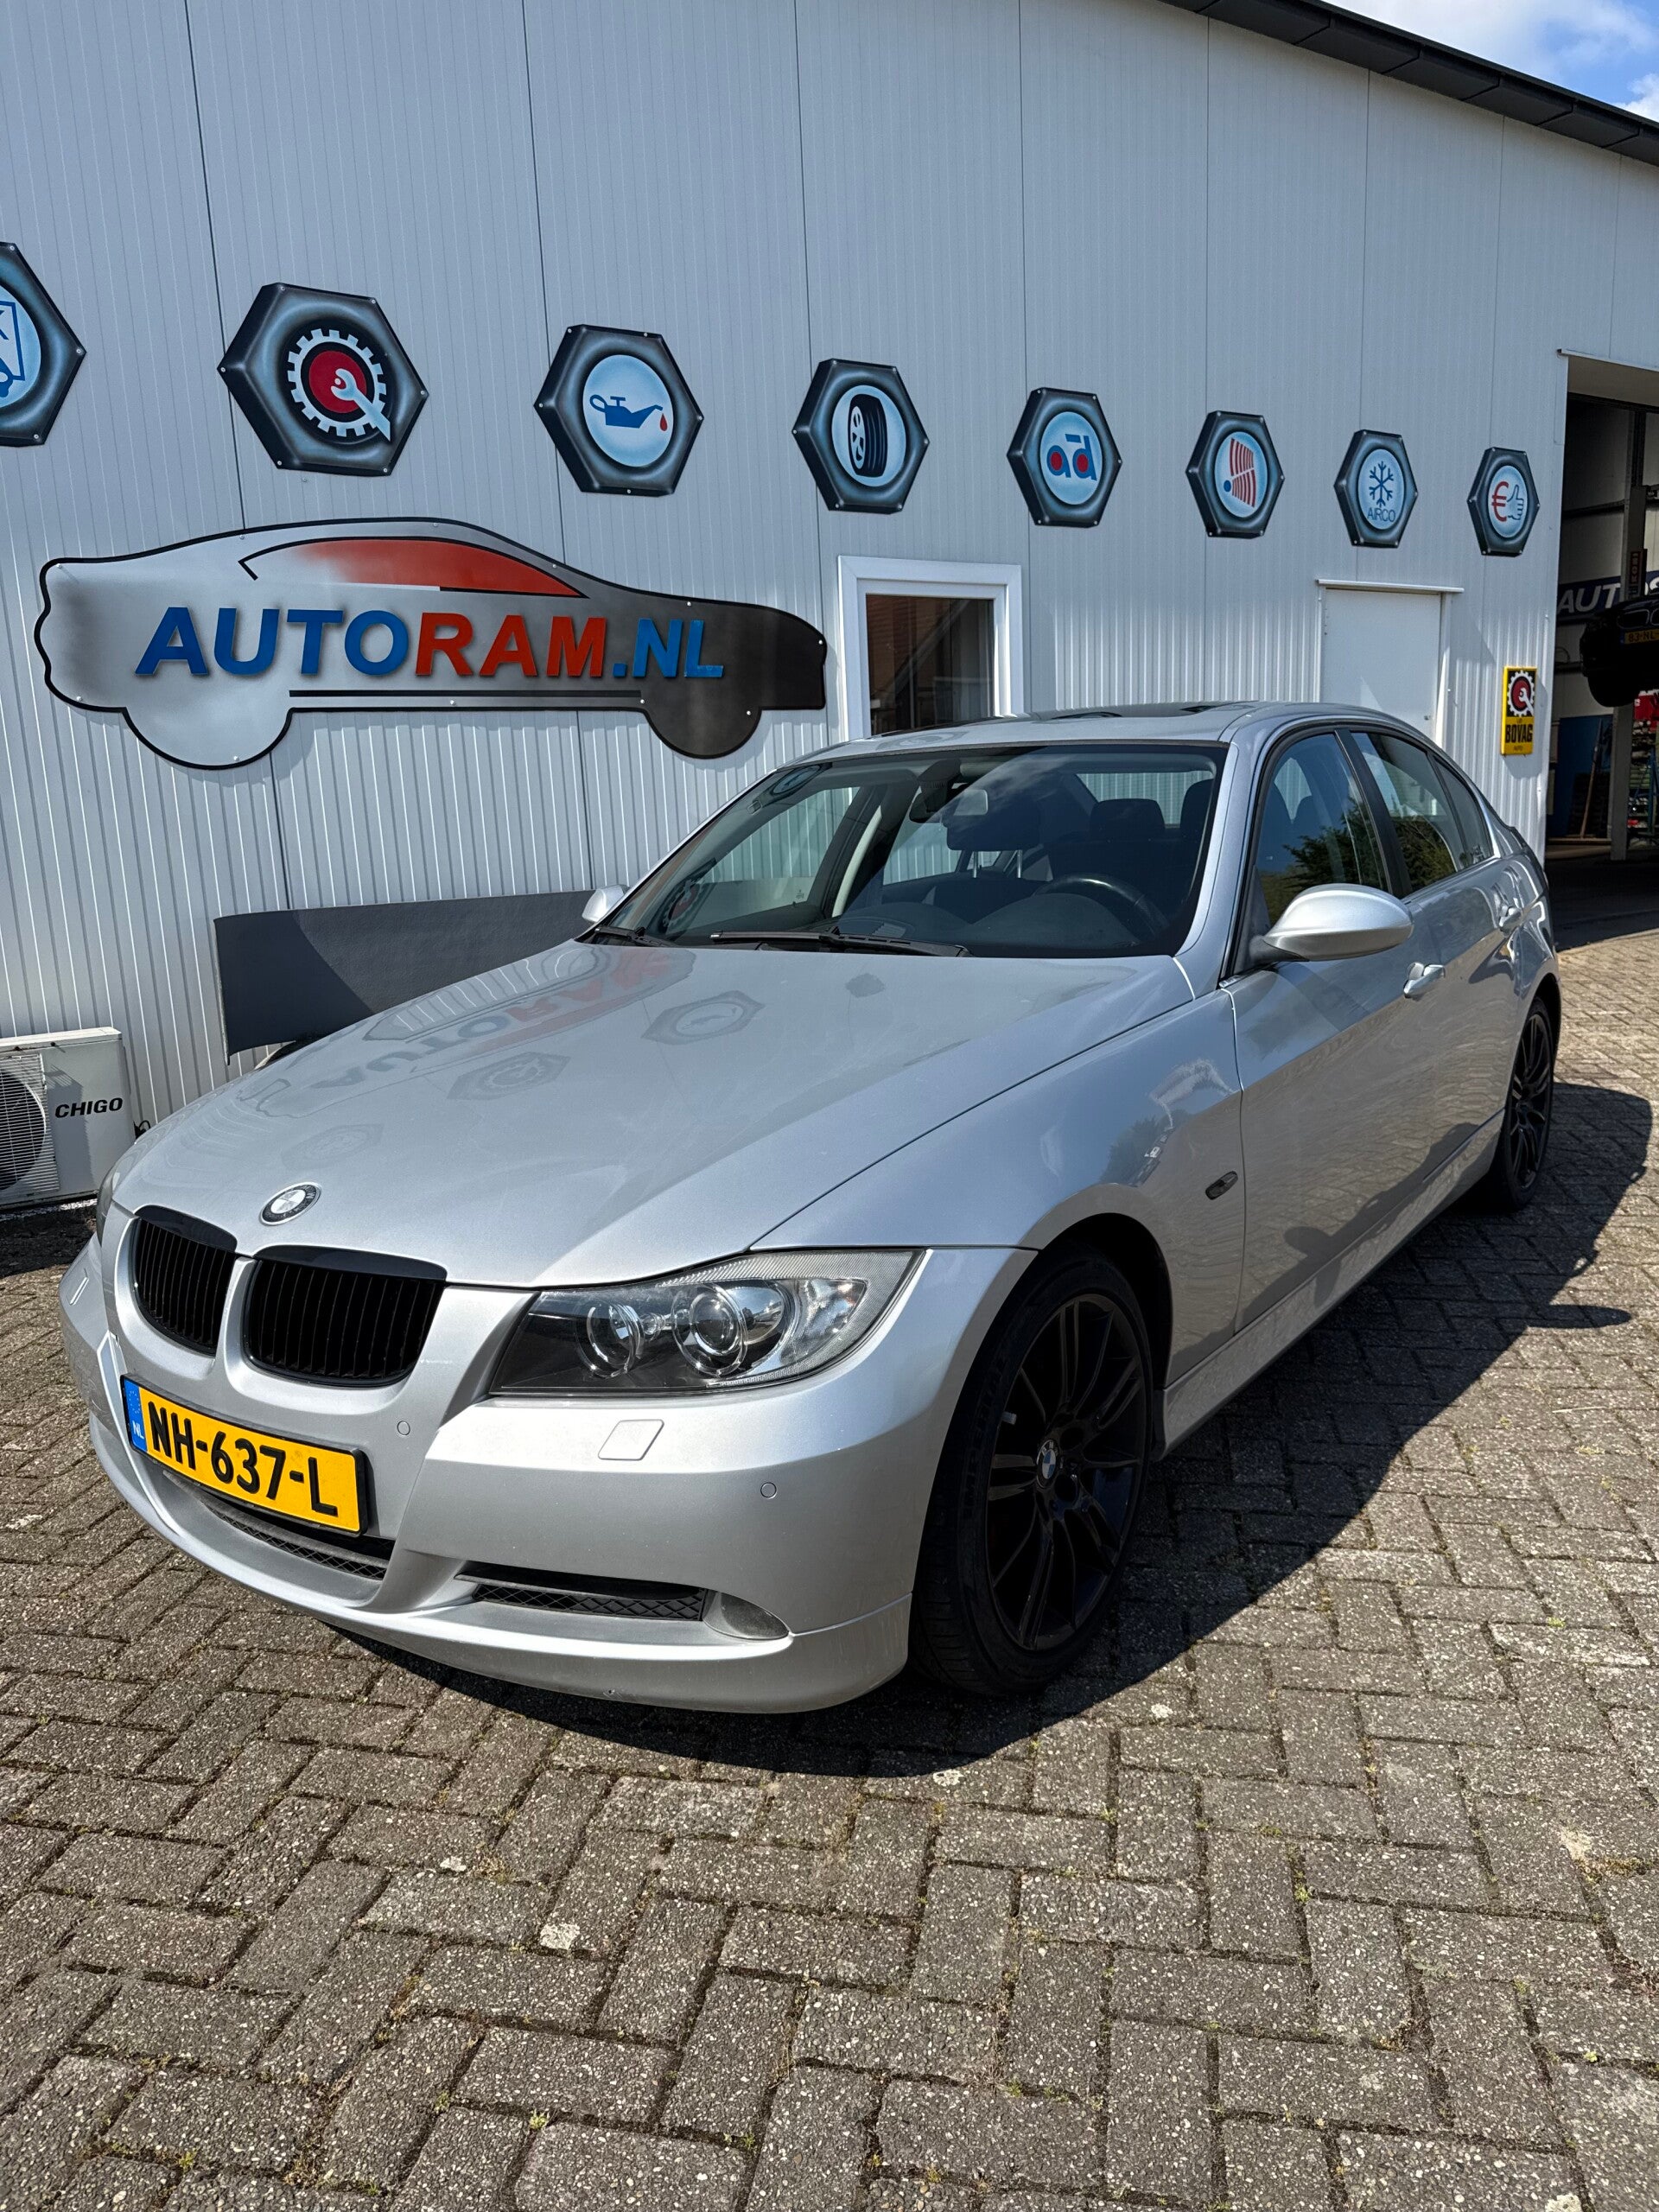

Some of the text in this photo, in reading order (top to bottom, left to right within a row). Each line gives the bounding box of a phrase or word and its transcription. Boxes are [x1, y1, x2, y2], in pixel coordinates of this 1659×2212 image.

[1367, 507, 1396, 523] AIRCO
[135, 607, 724, 678] AUTORAM.NL
[1505, 724, 1533, 743] BOVAG
[55, 1097, 124, 1119] CHIGO
[132, 1421, 145, 1440] NL
[148, 1401, 339, 1518] NH-637-L
